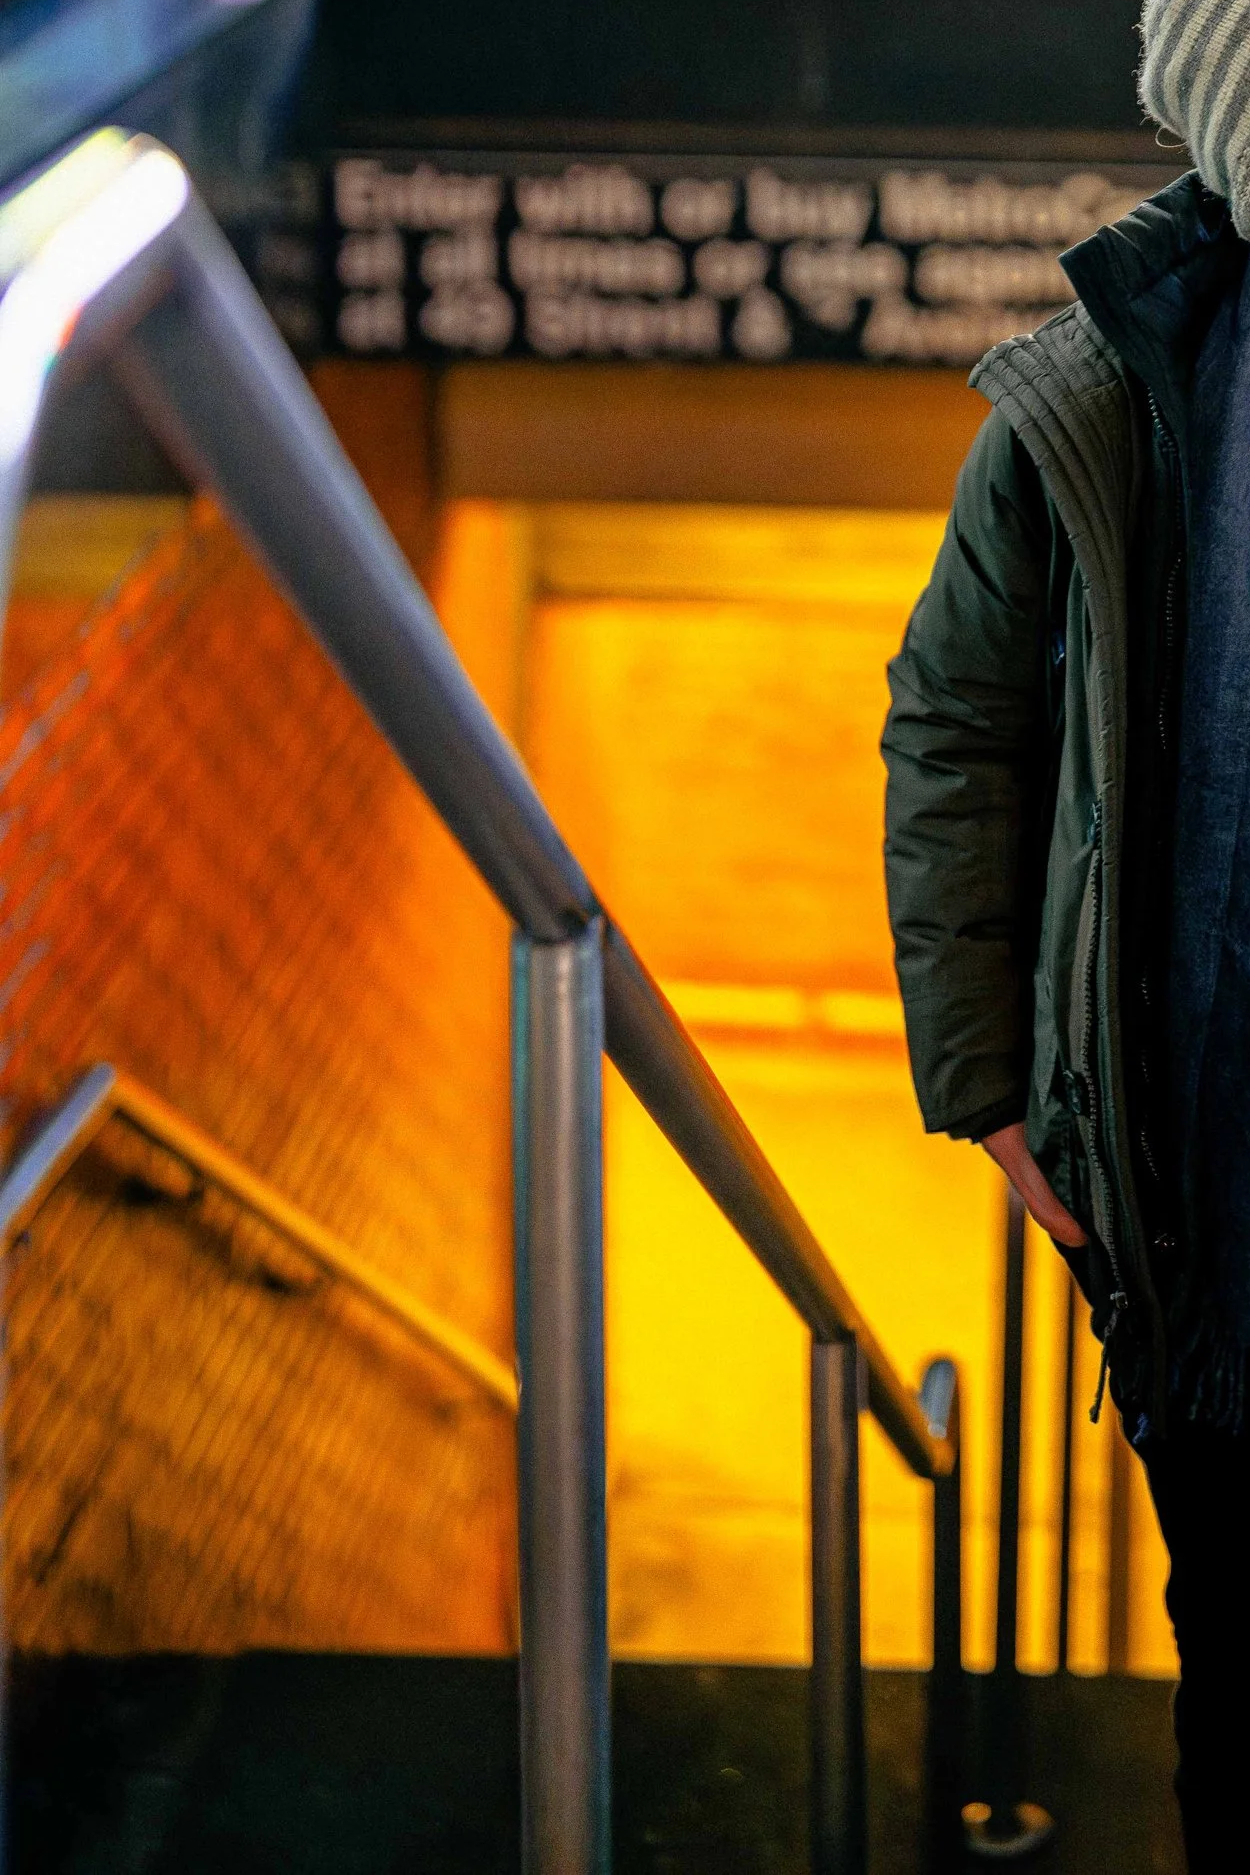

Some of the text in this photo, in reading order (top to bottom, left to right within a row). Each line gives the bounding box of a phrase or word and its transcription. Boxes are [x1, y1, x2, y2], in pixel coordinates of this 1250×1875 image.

[336, 160, 499, 226] Enter
[515, 164, 652, 231] with
[662, 178, 737, 237] or
[747, 169, 872, 249] buy
[338, 231, 403, 286] at
[421, 229, 497, 287] all
[508, 229, 683, 293] times
[694, 240, 768, 297] or
[338, 291, 403, 348] at
[421, 285, 513, 353] 49
[526, 289, 720, 356] Street
[733, 289, 789, 357] &
